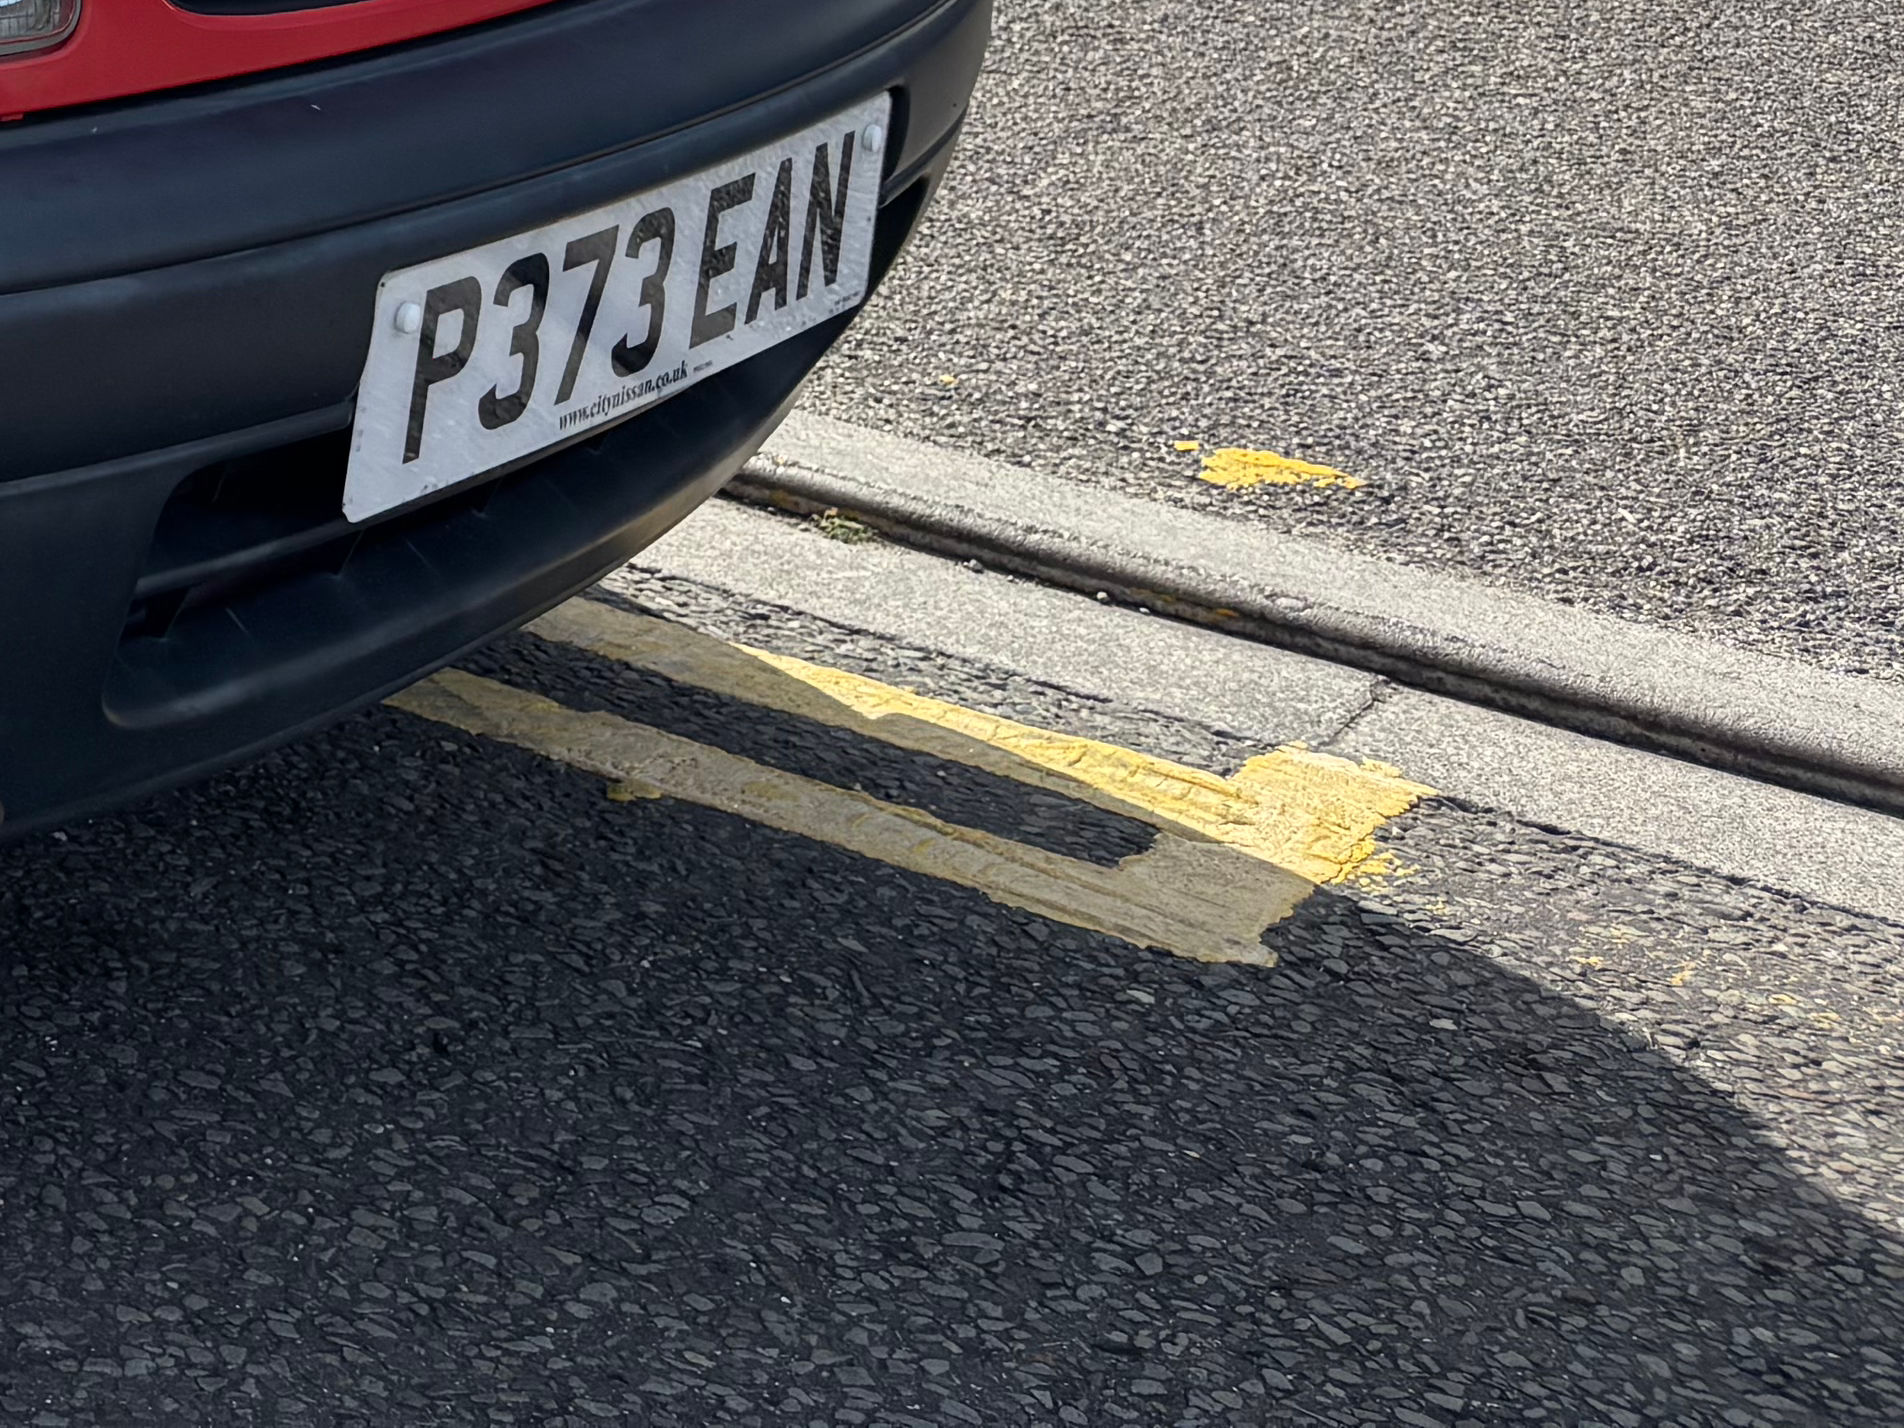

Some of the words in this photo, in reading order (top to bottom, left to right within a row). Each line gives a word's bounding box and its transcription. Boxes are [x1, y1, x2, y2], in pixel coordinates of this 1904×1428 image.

[402, 207, 676, 465] P373
[689, 130, 856, 350] EAN
[558, 359, 688, 431] www.citynissan.co.uk
